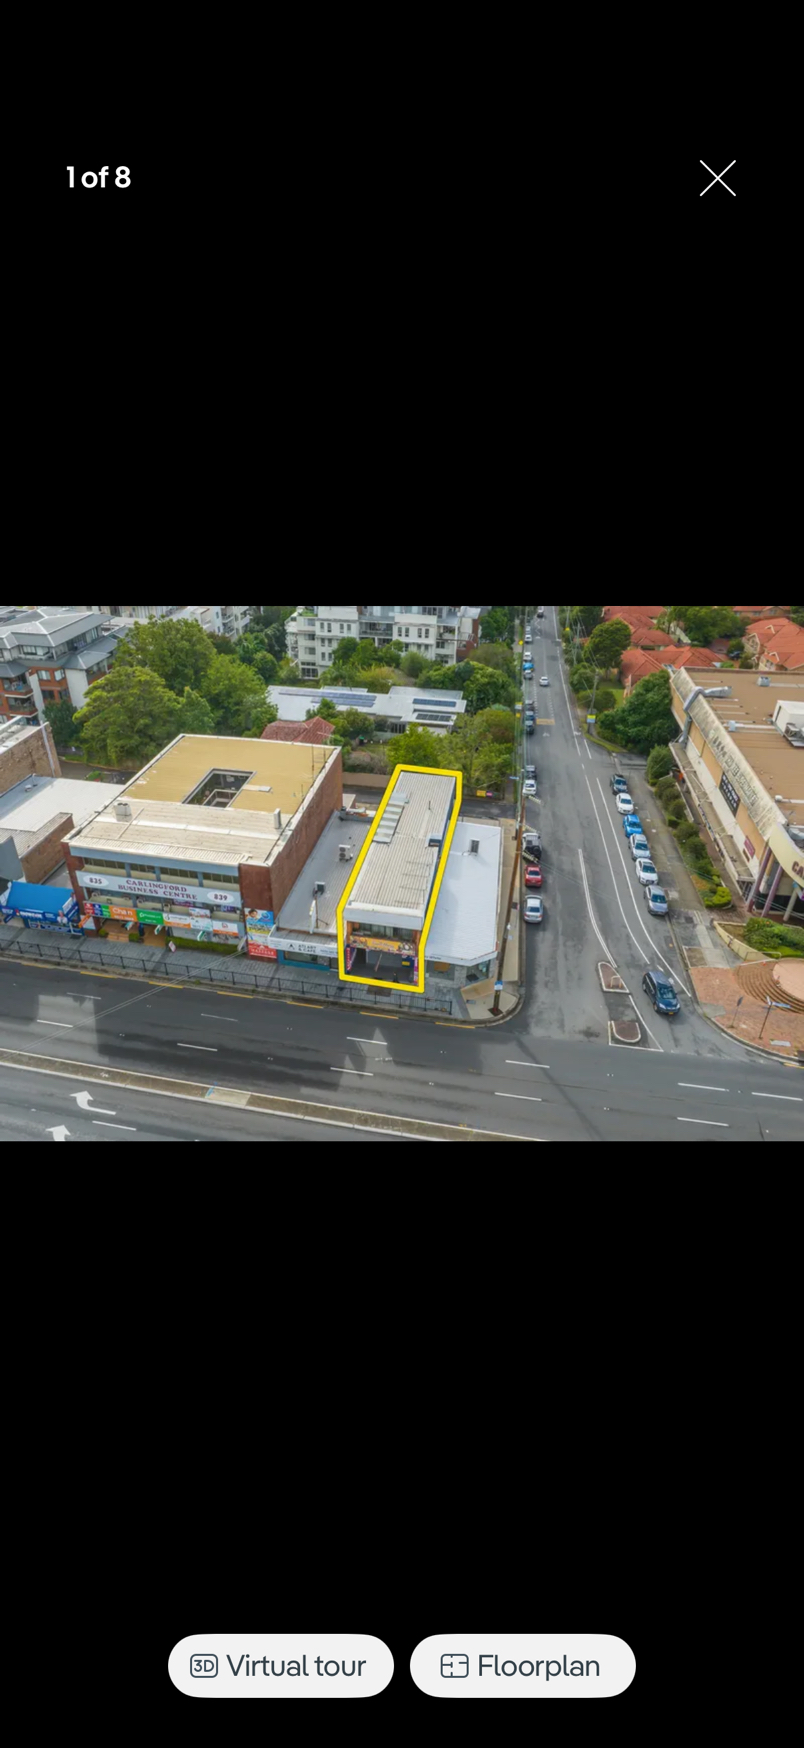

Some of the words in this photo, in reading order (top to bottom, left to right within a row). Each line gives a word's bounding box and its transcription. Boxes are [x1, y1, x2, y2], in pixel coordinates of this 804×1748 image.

[89, 877, 103, 885] 835
[126, 879, 187, 893] CARLINGFORD
[118, 885, 159, 896] BUSINESS
[163, 890, 198, 900] CENTRE
[213, 893, 228, 901] 839
